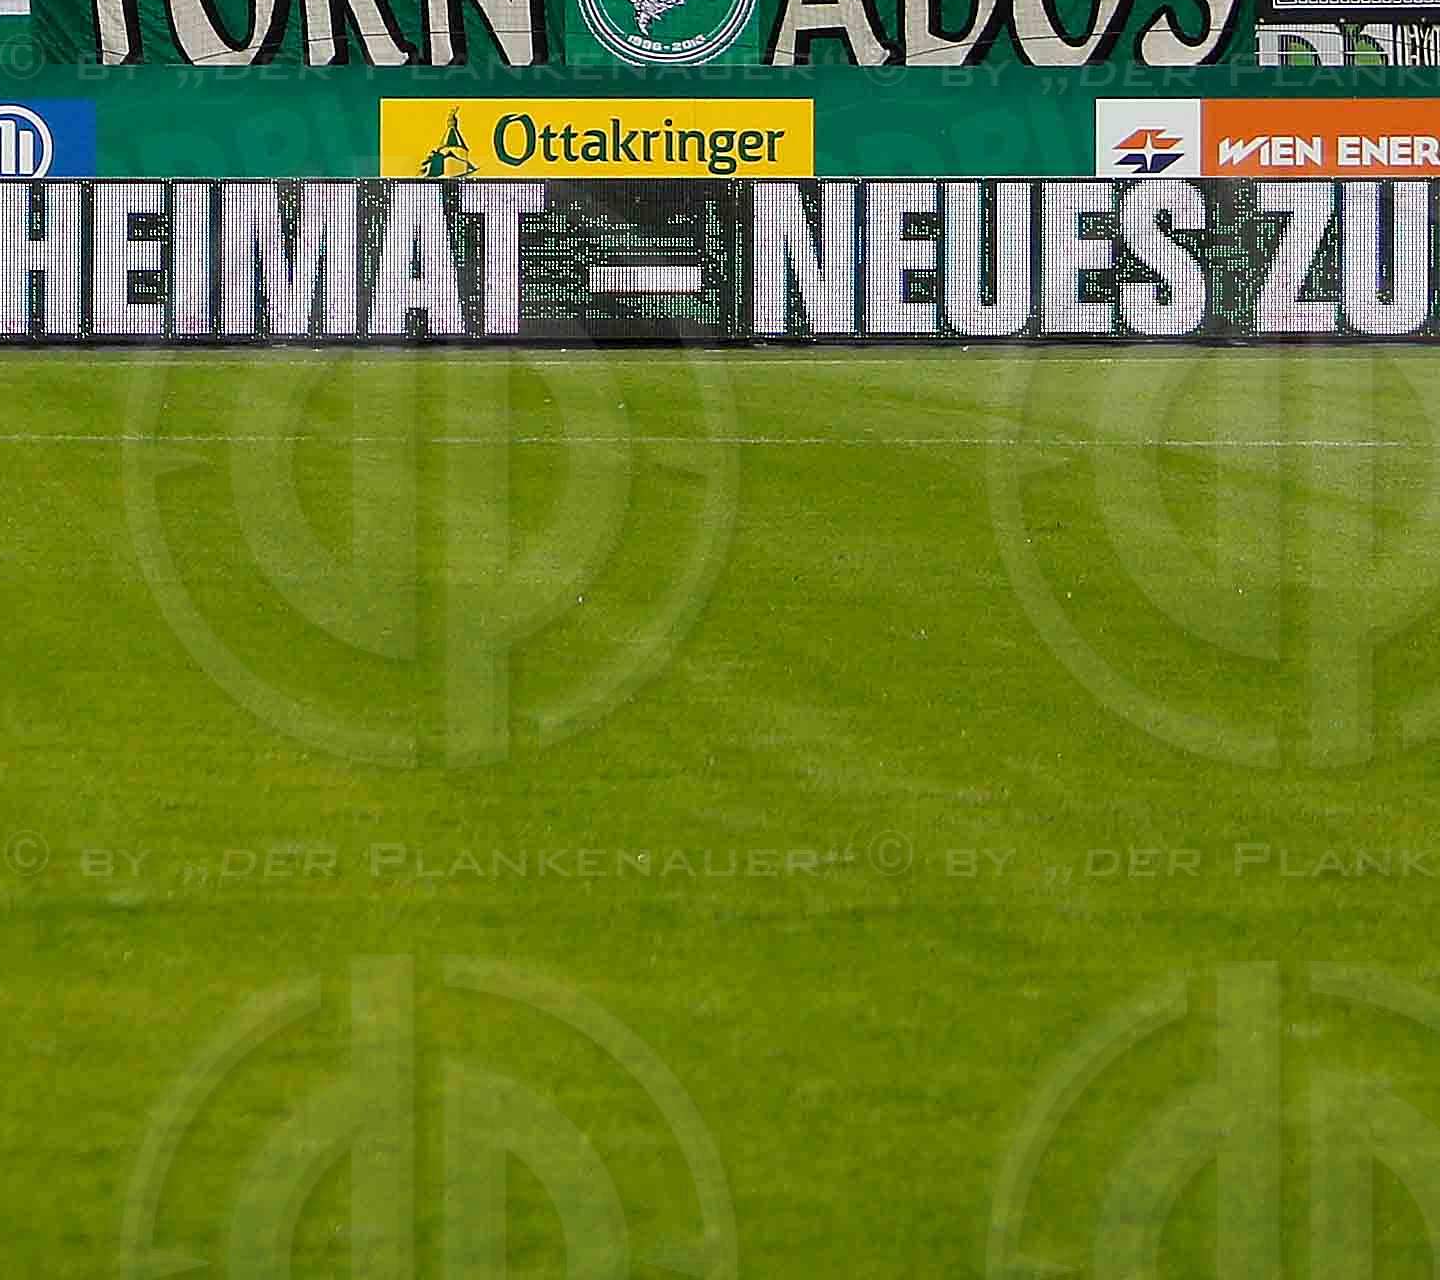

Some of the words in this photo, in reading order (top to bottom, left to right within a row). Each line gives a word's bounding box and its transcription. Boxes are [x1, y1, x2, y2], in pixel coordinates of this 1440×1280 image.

[492, 112, 786, 174] Ottakringer
[1216, 134, 1323, 167] WIEN
[750, 181, 1209, 336] NEUES
